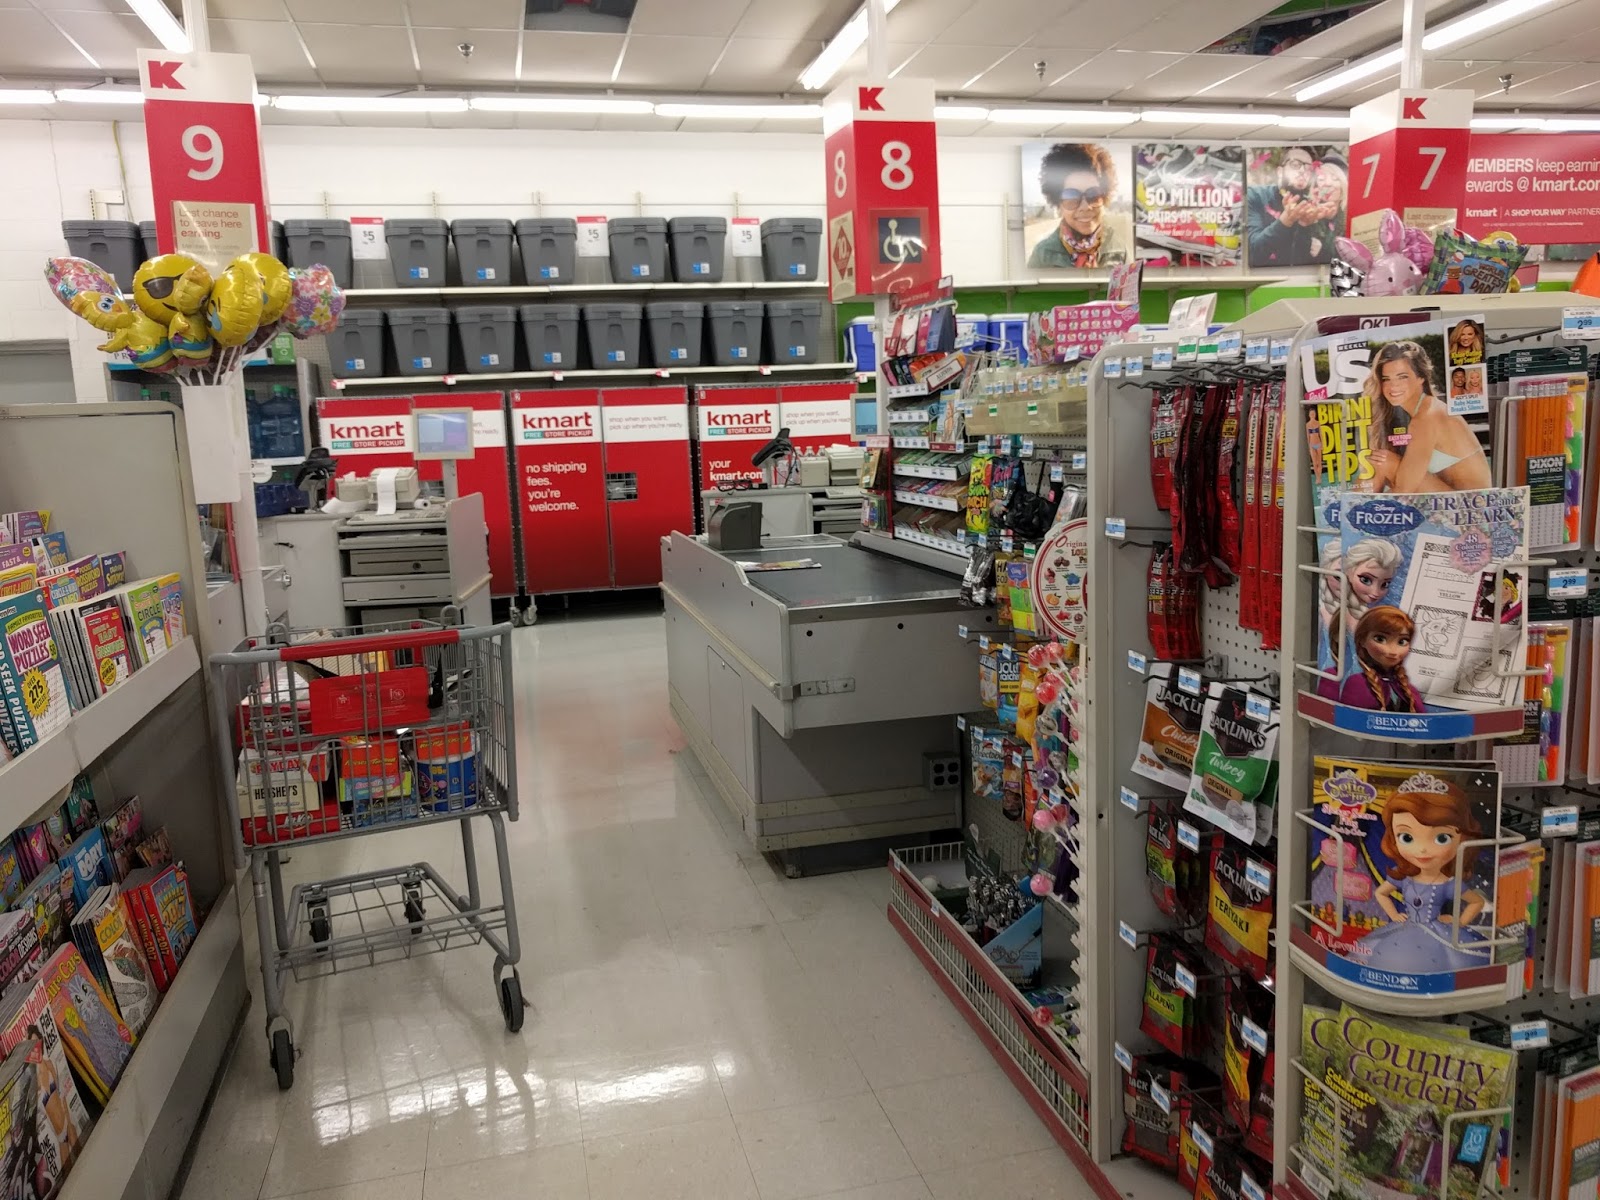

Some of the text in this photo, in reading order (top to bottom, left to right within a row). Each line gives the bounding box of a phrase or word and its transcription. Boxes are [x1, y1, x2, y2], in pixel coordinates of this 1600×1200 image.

[147, 60, 187, 90] K
[859, 87, 885, 111] K
[1403, 97, 1428, 119] K
[181, 124, 224, 181] 9
[834, 150, 847, 198] 8
[881, 140, 914, 190] 8
[1418, 147, 1446, 190] 7
[1536, 158, 1565, 175] keep
[1566, 158, 1600, 172] earnin
[1362, 153, 1380, 198] 7
[1466, 177, 1514, 192] ewards
[1517, 176, 1529, 192] @
[1145, 188, 1234, 207] 50 MILLION
[202, 208, 239, 218] chance
[1147, 210, 1231, 224] PAIRS OF SHOES
[1466, 208, 1498, 217] kmart
[1511, 209, 1530, 217] SHOP
[1550, 208, 1565, 216] WAY
[180, 218, 242, 229] to eave here
[1361, 317, 1389, 330] OK!
[1337, 341, 1368, 352] WEEKLY
[522, 412, 592, 430] kmart
[707, 409, 772, 427] kmart
[330, 420, 404, 440] kmart
[524, 429, 593, 439] FREE STORE PICKUP
[708, 426, 772, 436] FREE STORE PICKUP
[1320, 419, 1372, 454] DIET
[332, 438, 405, 450] FREE STORE PICKUP
[526, 462, 587, 474] no shipping
[709, 460, 731, 470] your
[1321, 449, 1376, 484] TIPS
[1529, 457, 1564, 470] DIXON
[527, 476, 552, 488] fees.
[710, 470, 764, 482] kmart.com
[528, 490, 561, 502] you're
[1428, 493, 1497, 512] TRACE
[529, 502, 579, 513] welcome.
[1372, 503, 1396, 513] Disney
[1453, 507, 1516, 526] LEARN
[1356, 511, 1414, 525] FROZEN
[1055, 535, 1087, 548] Origina
[1455, 543, 1488, 551] Coloring
[1466, 534, 1478, 543] 48
[137, 603, 161, 622] CIRCLE
[8, 621, 51, 655] WORD SEEK
[14, 641, 50, 673] PUZZLES
[27, 676, 36, 688] OVER
[29, 681, 44, 703] 275
[1157, 685, 1189, 712] JACK
[1, 662, 34, 750] SEEK PUZZLE
[1210, 711, 1231, 736] JACK
[1375, 716, 1428, 728] BENDON
[1164, 747, 1193, 766] ORIGINA
[256, 758, 301, 775] PYDAY
[1209, 751, 1246, 783] Turkey
[254, 785, 298, 800] HESHEY'S
[1207, 777, 1232, 797] ORIGINAL
[1214, 856, 1235, 884] JACK
[1214, 895, 1250, 933] TERIYAKI
[100, 914, 123, 944] COLOR
[1368, 970, 1418, 986] BENDON
[1343, 1016, 1499, 1093] Country
[1326, 1067, 1377, 1105] Celebrate
[1350, 1053, 1478, 1111] Gardens
[1324, 1074, 1367, 1110] Summer
